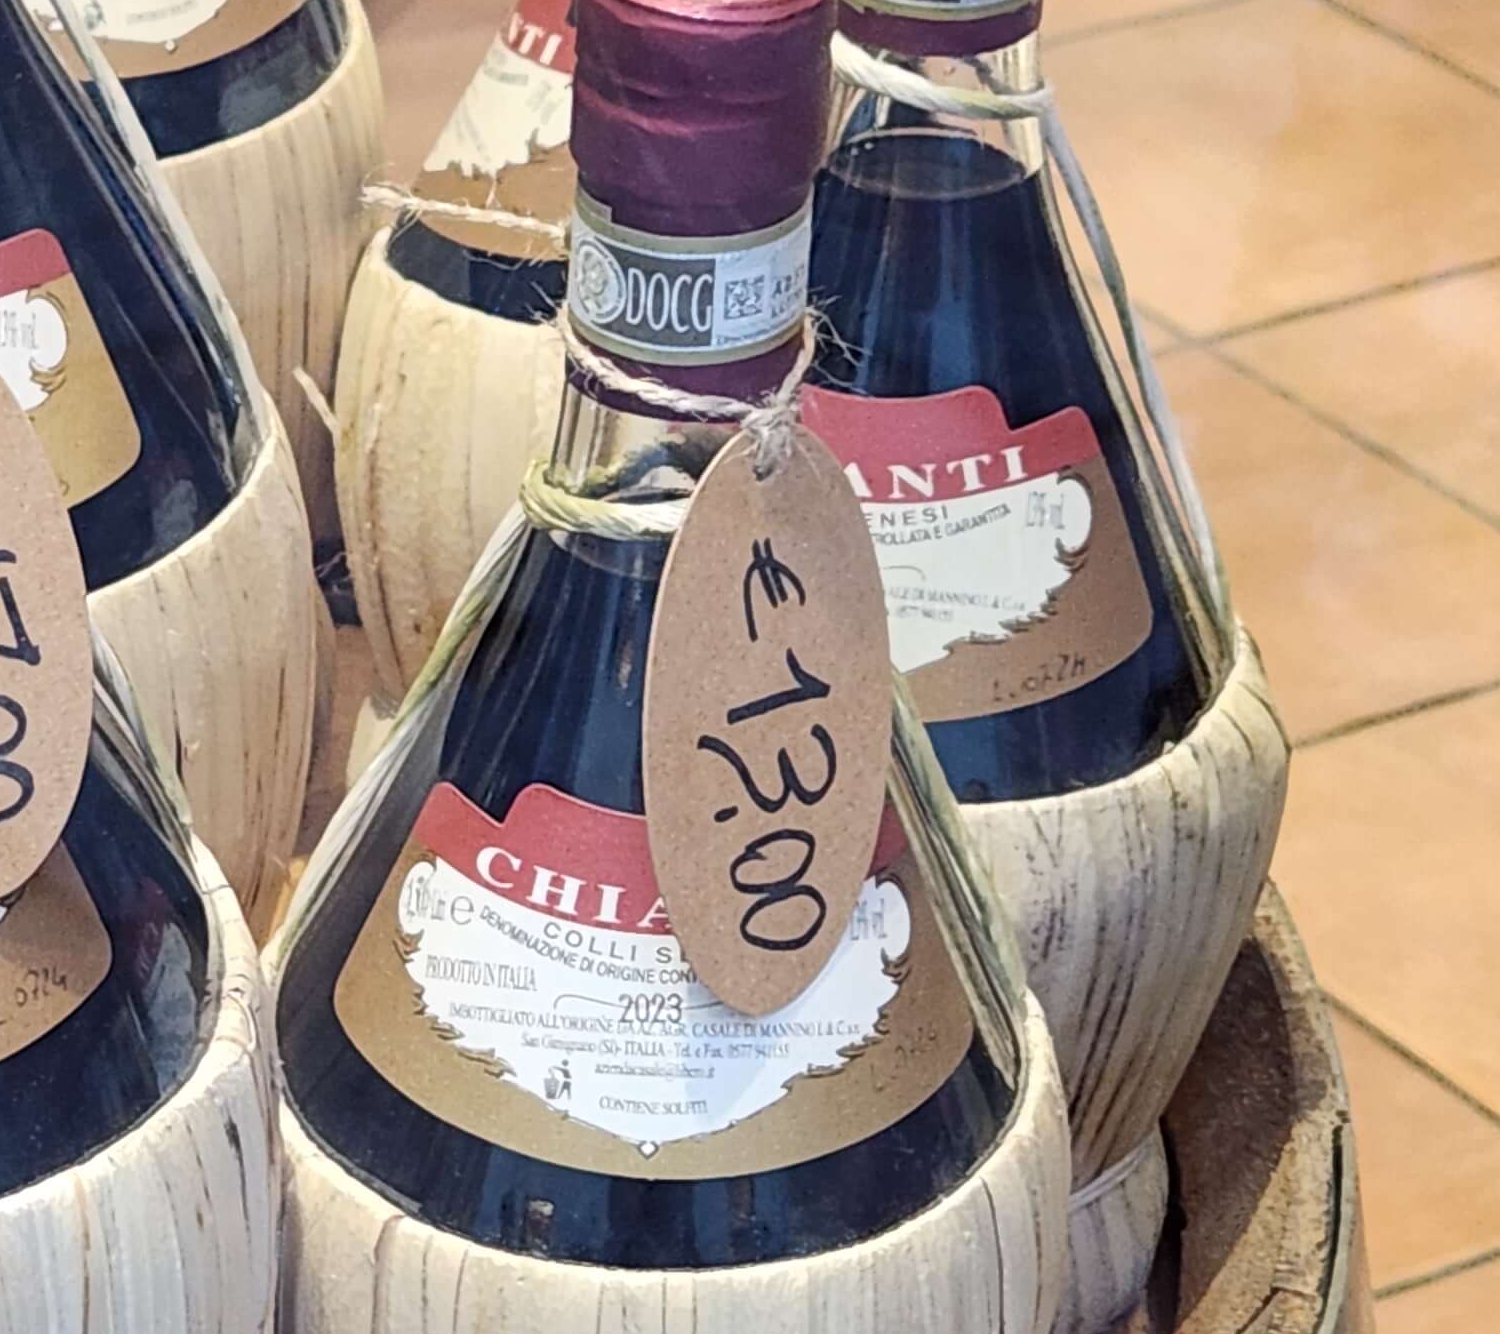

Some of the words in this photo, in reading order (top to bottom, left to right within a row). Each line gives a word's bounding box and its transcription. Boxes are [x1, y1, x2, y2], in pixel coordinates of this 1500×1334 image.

[626, 268, 712, 332] DOCG
[843, 446, 1028, 499] ANTI
[476, 846, 672, 929] CHIA
[543, 921, 637, 963] COLLI
[580, 956, 594, 973] DI
[596, 961, 656, 984] ORIGINE
[618, 992, 683, 1024] 2023
